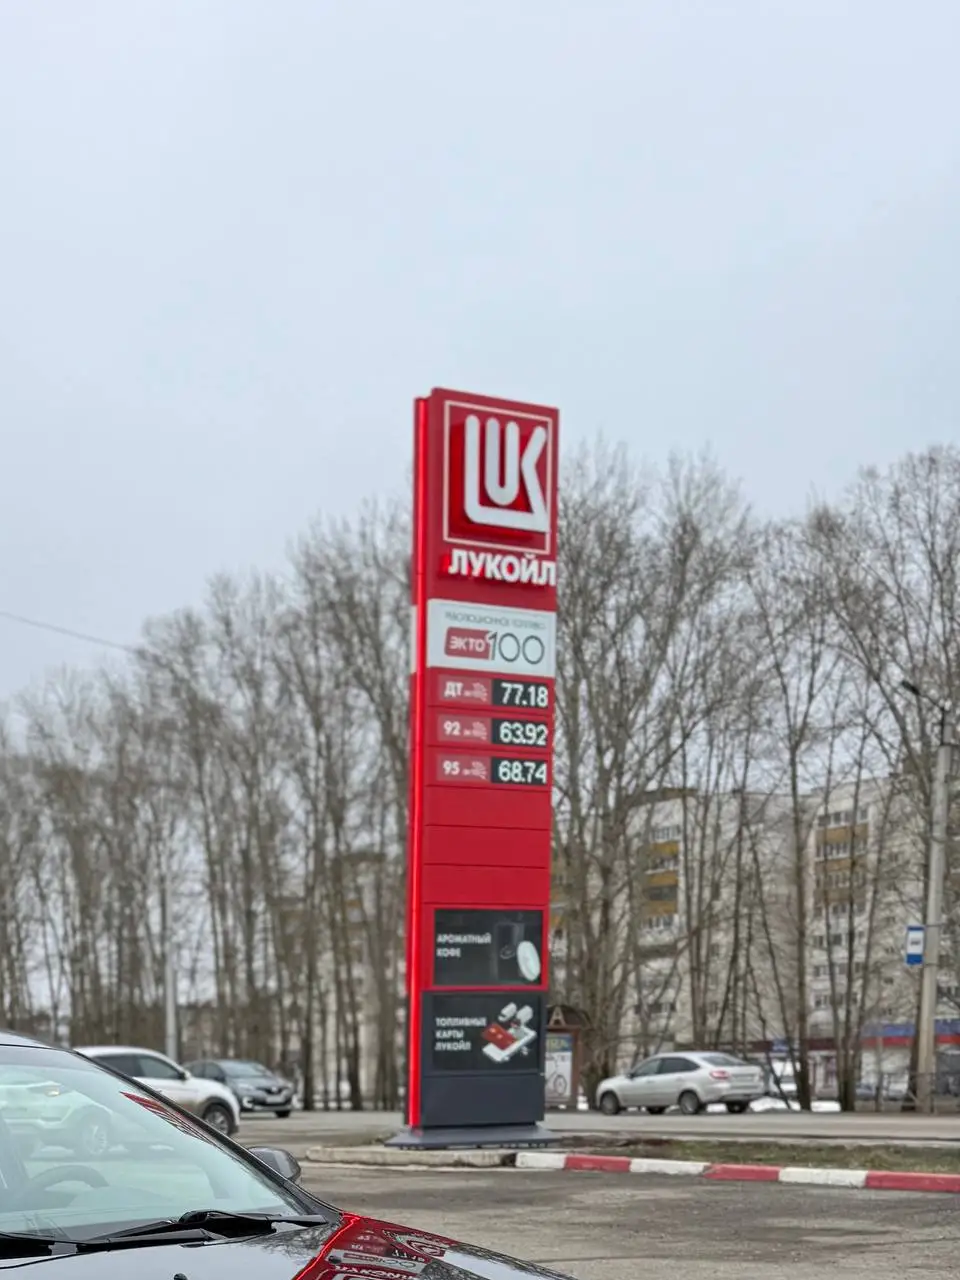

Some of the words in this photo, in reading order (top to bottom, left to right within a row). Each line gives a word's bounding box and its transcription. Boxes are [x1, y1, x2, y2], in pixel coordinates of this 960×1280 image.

[448, 548, 556, 586] ЛУКОЙЛ
[449, 635, 486, 653] ЭКТО
[486, 632, 545, 665] 100
[443, 681, 464, 698] ДТ
[501, 682, 549, 707] 77.18
[443, 720, 461, 736] 92
[499, 722, 548, 746] 63.92
[442, 760, 460, 775] 95
[498, 760, 547, 784] 68.74
[436, 931, 492, 945] АРОМАТНЫЙ
[436, 947, 461, 958] КОФЕ
[434, 1039, 472, 1051] ЛУКОЙЛ
[435, 1029, 464, 1039] КАРТЫ
